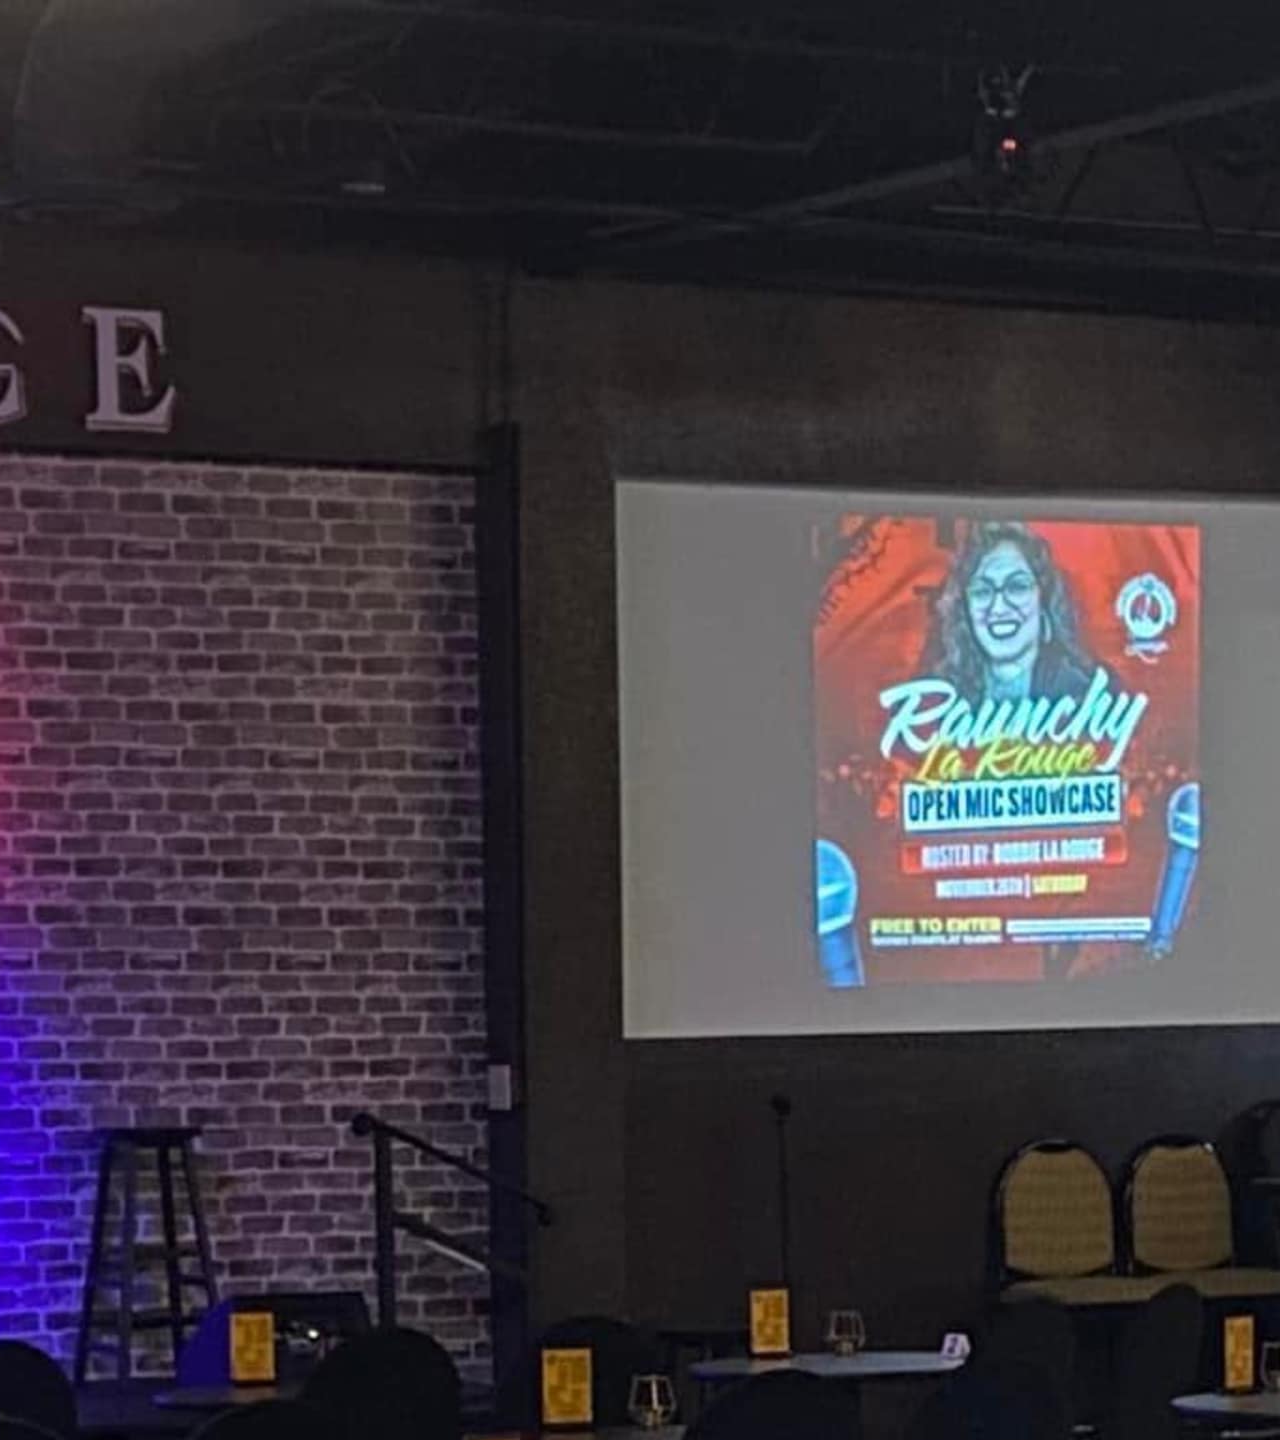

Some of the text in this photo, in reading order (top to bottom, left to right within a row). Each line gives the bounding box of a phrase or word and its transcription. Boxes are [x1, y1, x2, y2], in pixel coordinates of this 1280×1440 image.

[880, 667, 1148, 772] Raunchy
[919, 738, 1097, 784] La Rouge
[908, 782, 1116, 821] OPEN MIC SHOWCASE
